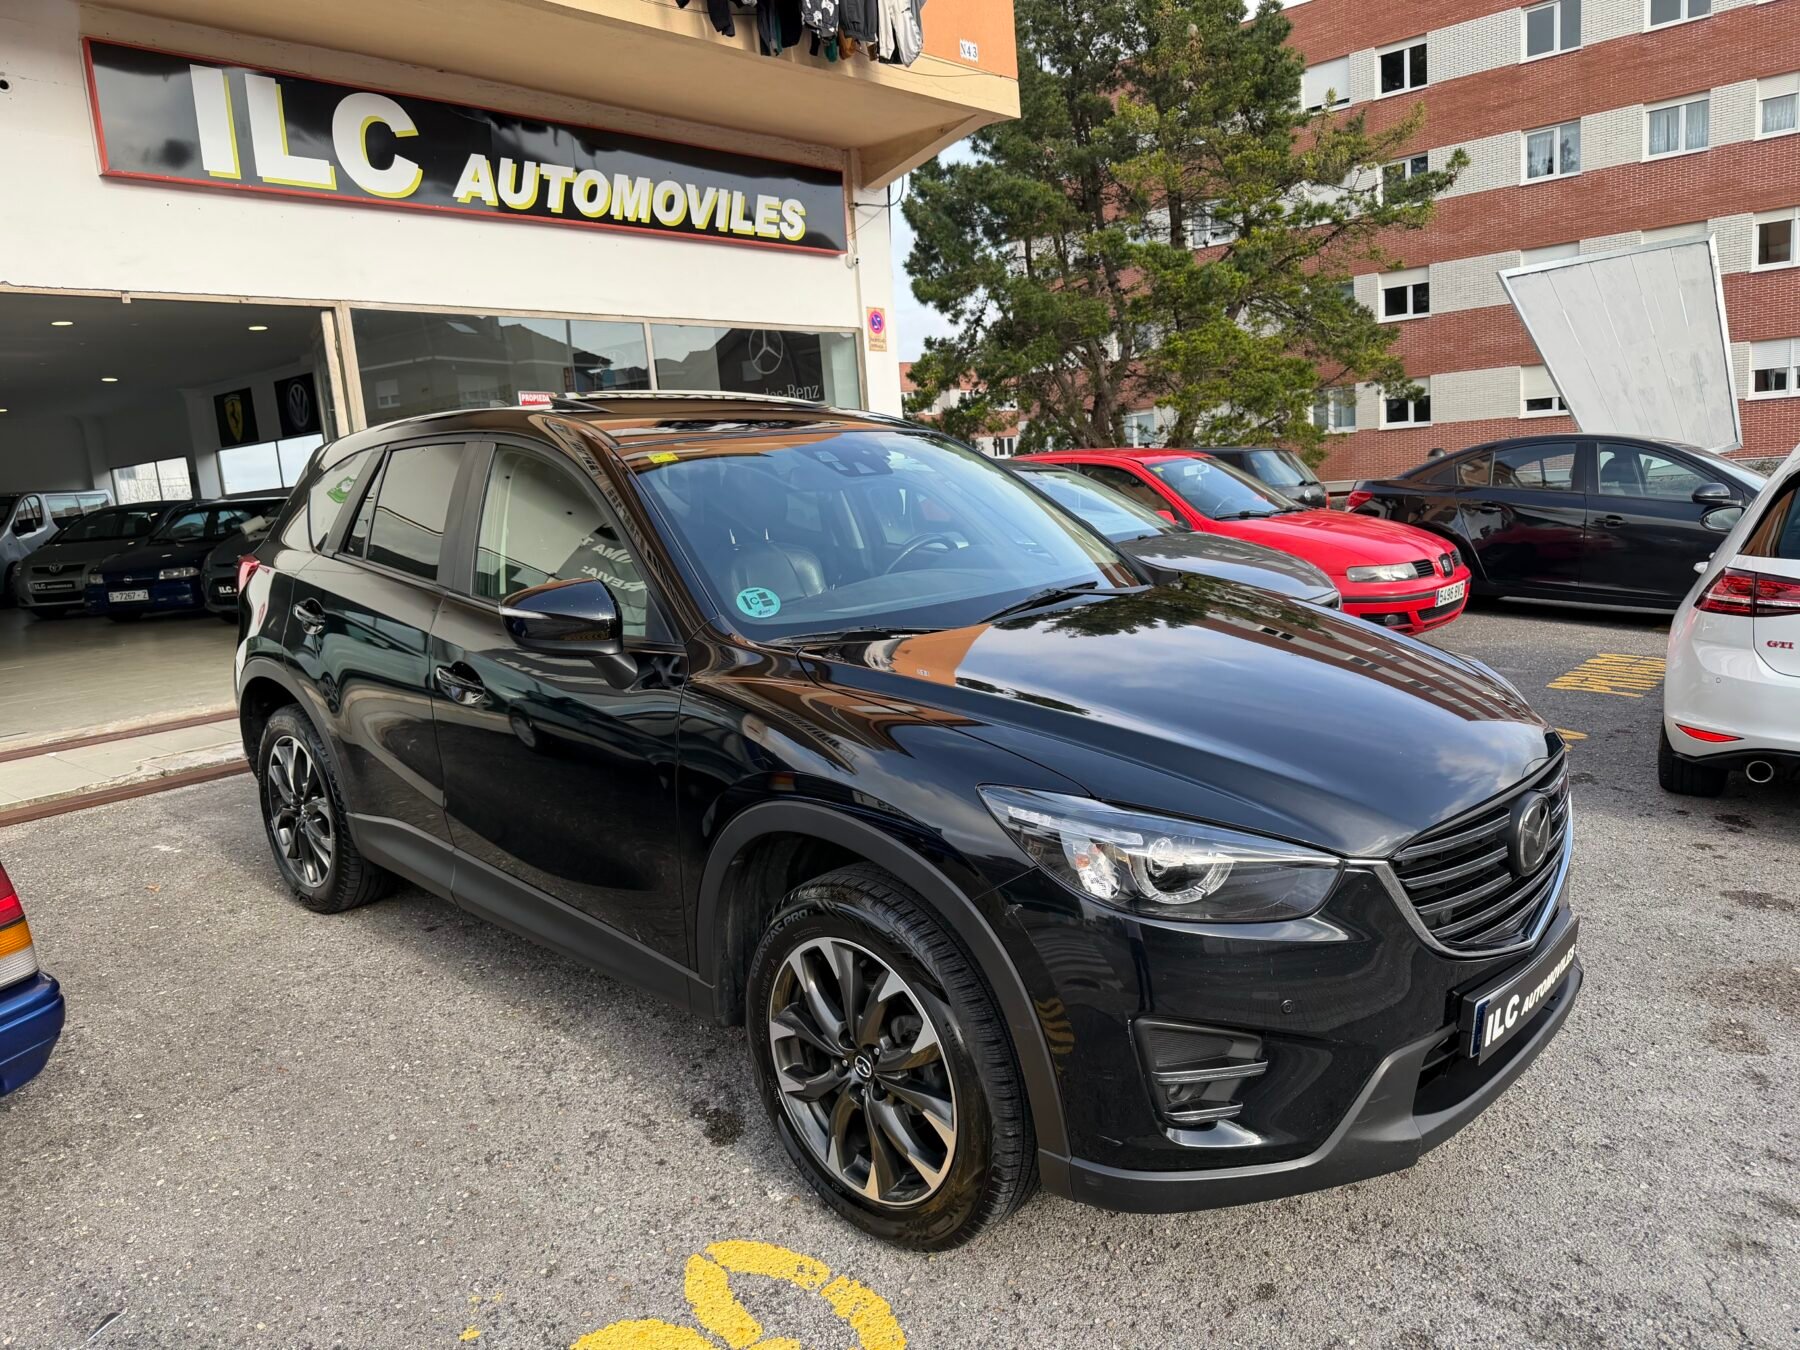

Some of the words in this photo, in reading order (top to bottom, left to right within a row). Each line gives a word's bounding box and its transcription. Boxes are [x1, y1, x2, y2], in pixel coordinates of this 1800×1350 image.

[190, 64, 423, 198] ILC
[452, 153, 806, 241] AUTOMOVILES
[1766, 640, 1795, 650] GTI
[1484, 994, 1520, 1047] ILC
[1520, 943, 1576, 1016] AUTOMOVILES
